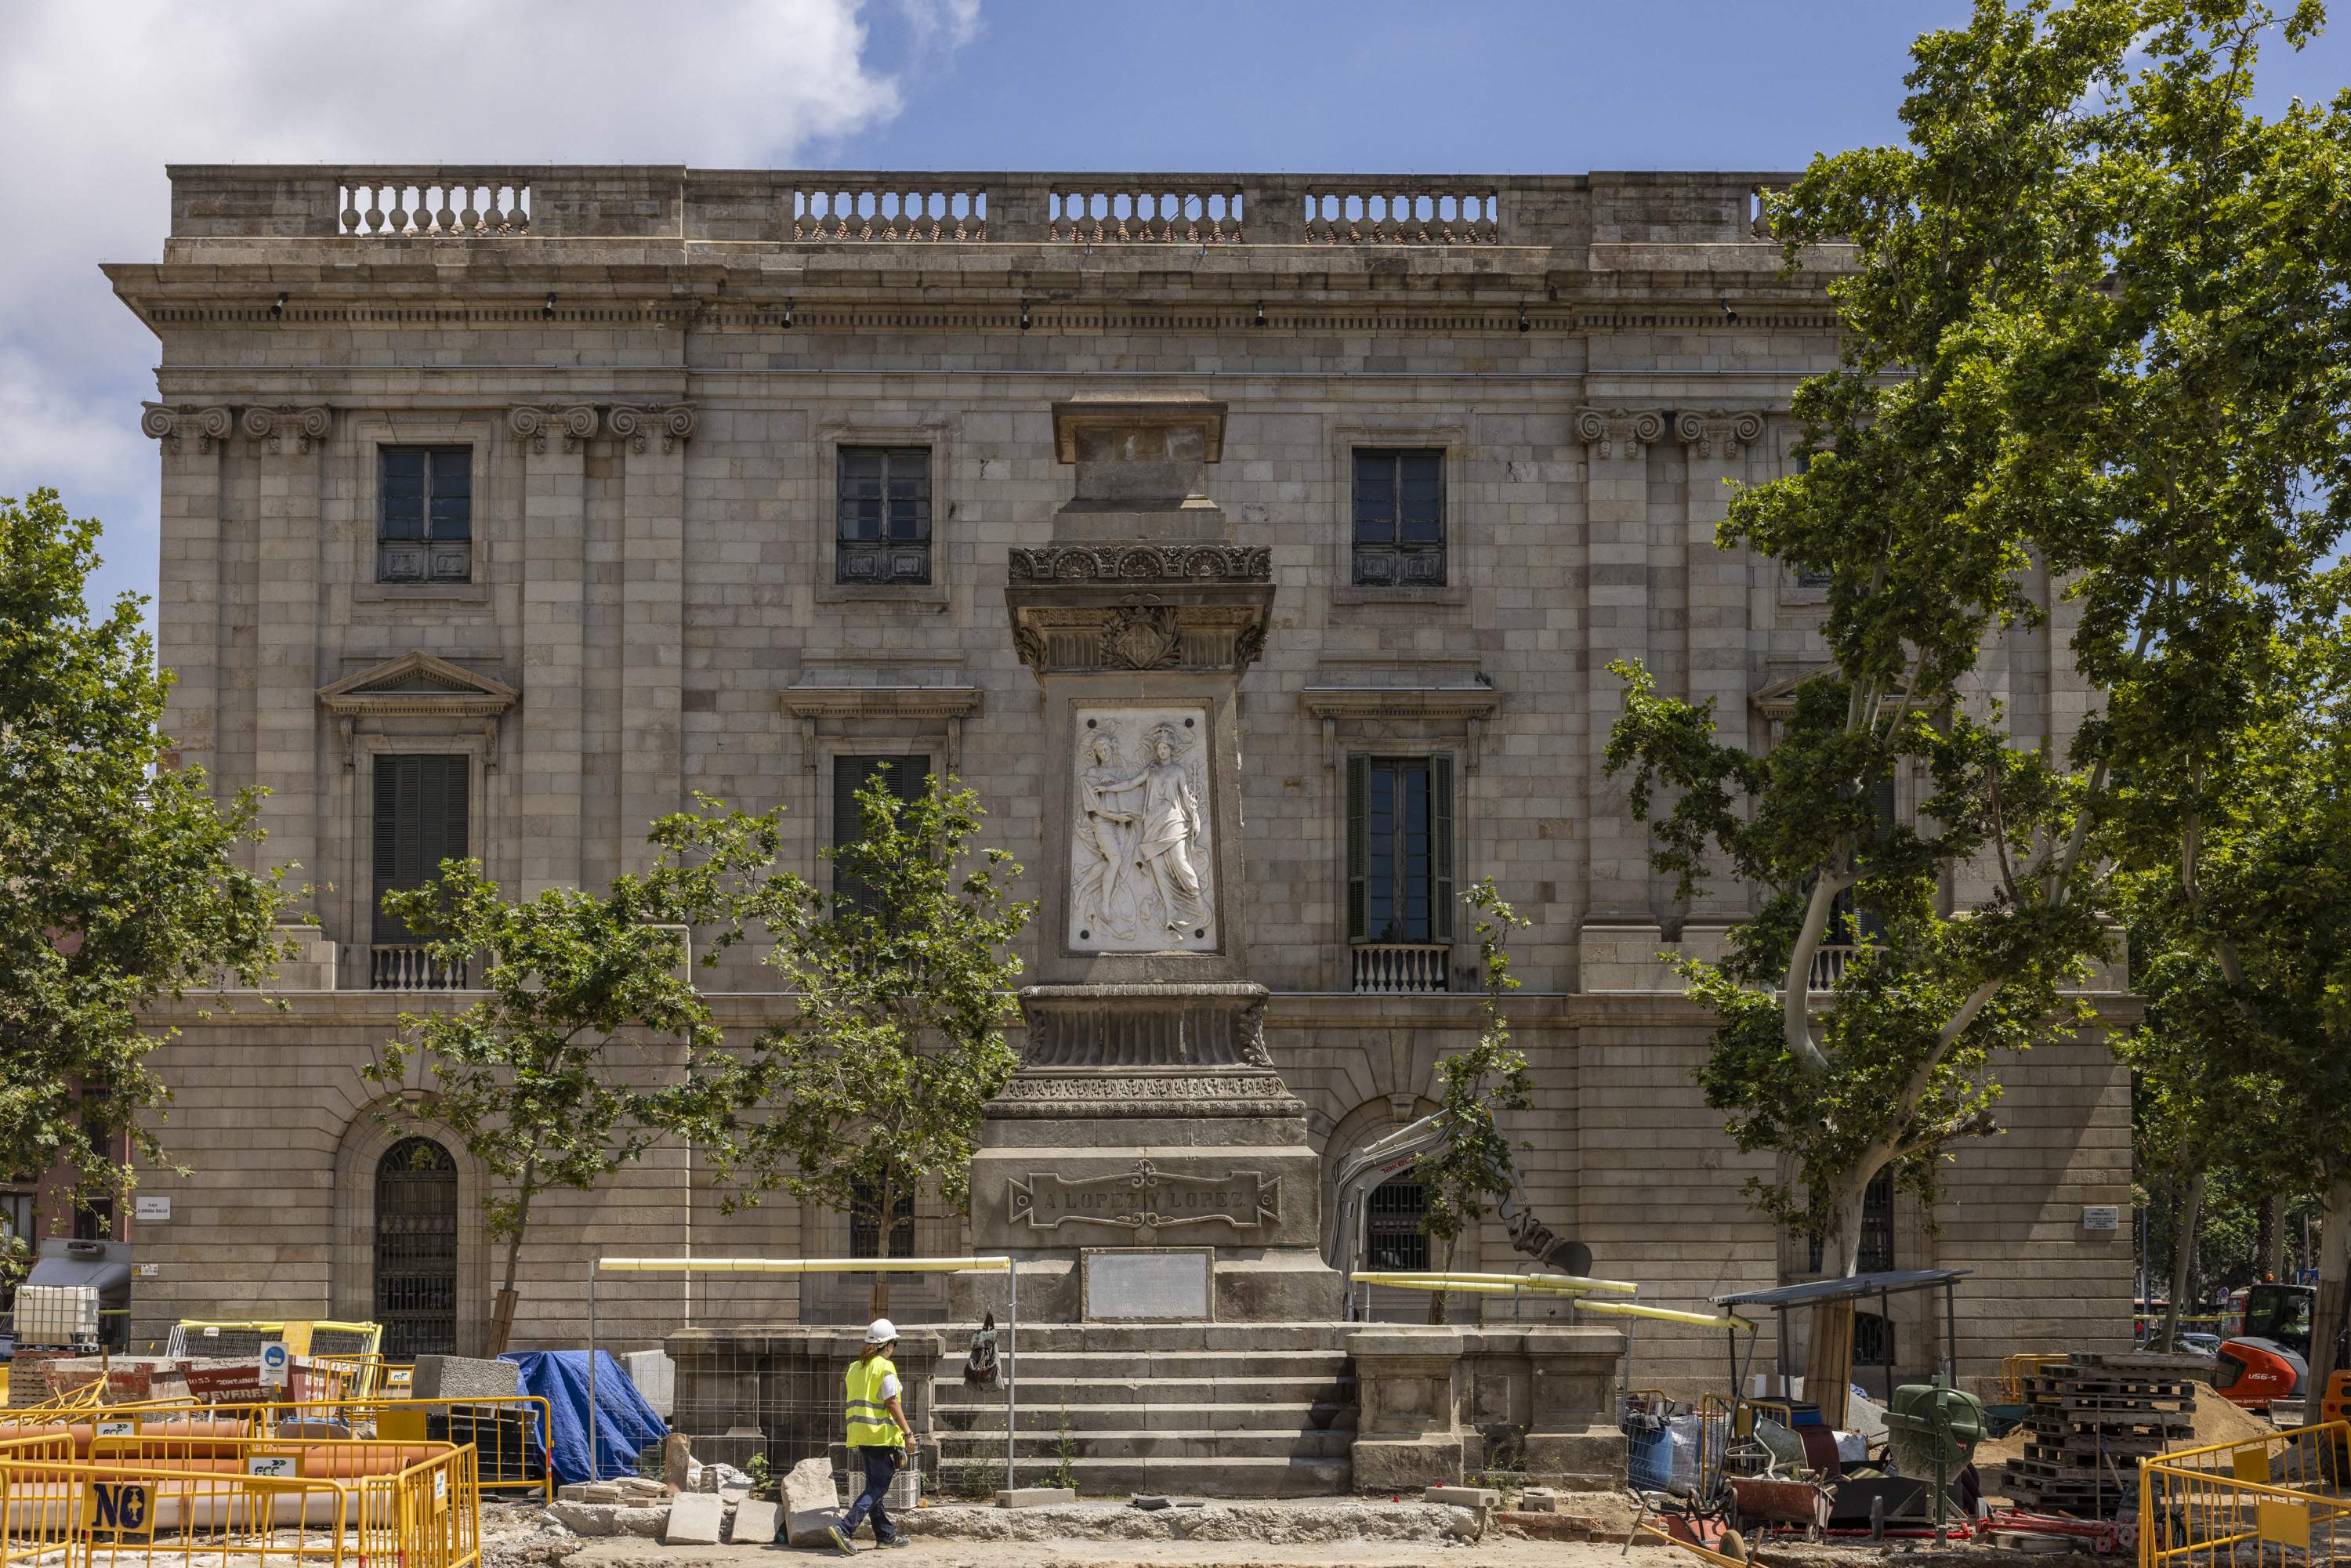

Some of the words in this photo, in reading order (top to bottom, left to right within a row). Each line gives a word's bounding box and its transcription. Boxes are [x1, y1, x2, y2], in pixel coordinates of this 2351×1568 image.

[1044, 1193, 1056, 1209] A
[255, 1466, 280, 1476] FCC
[91, 1483, 145, 1530] NO
